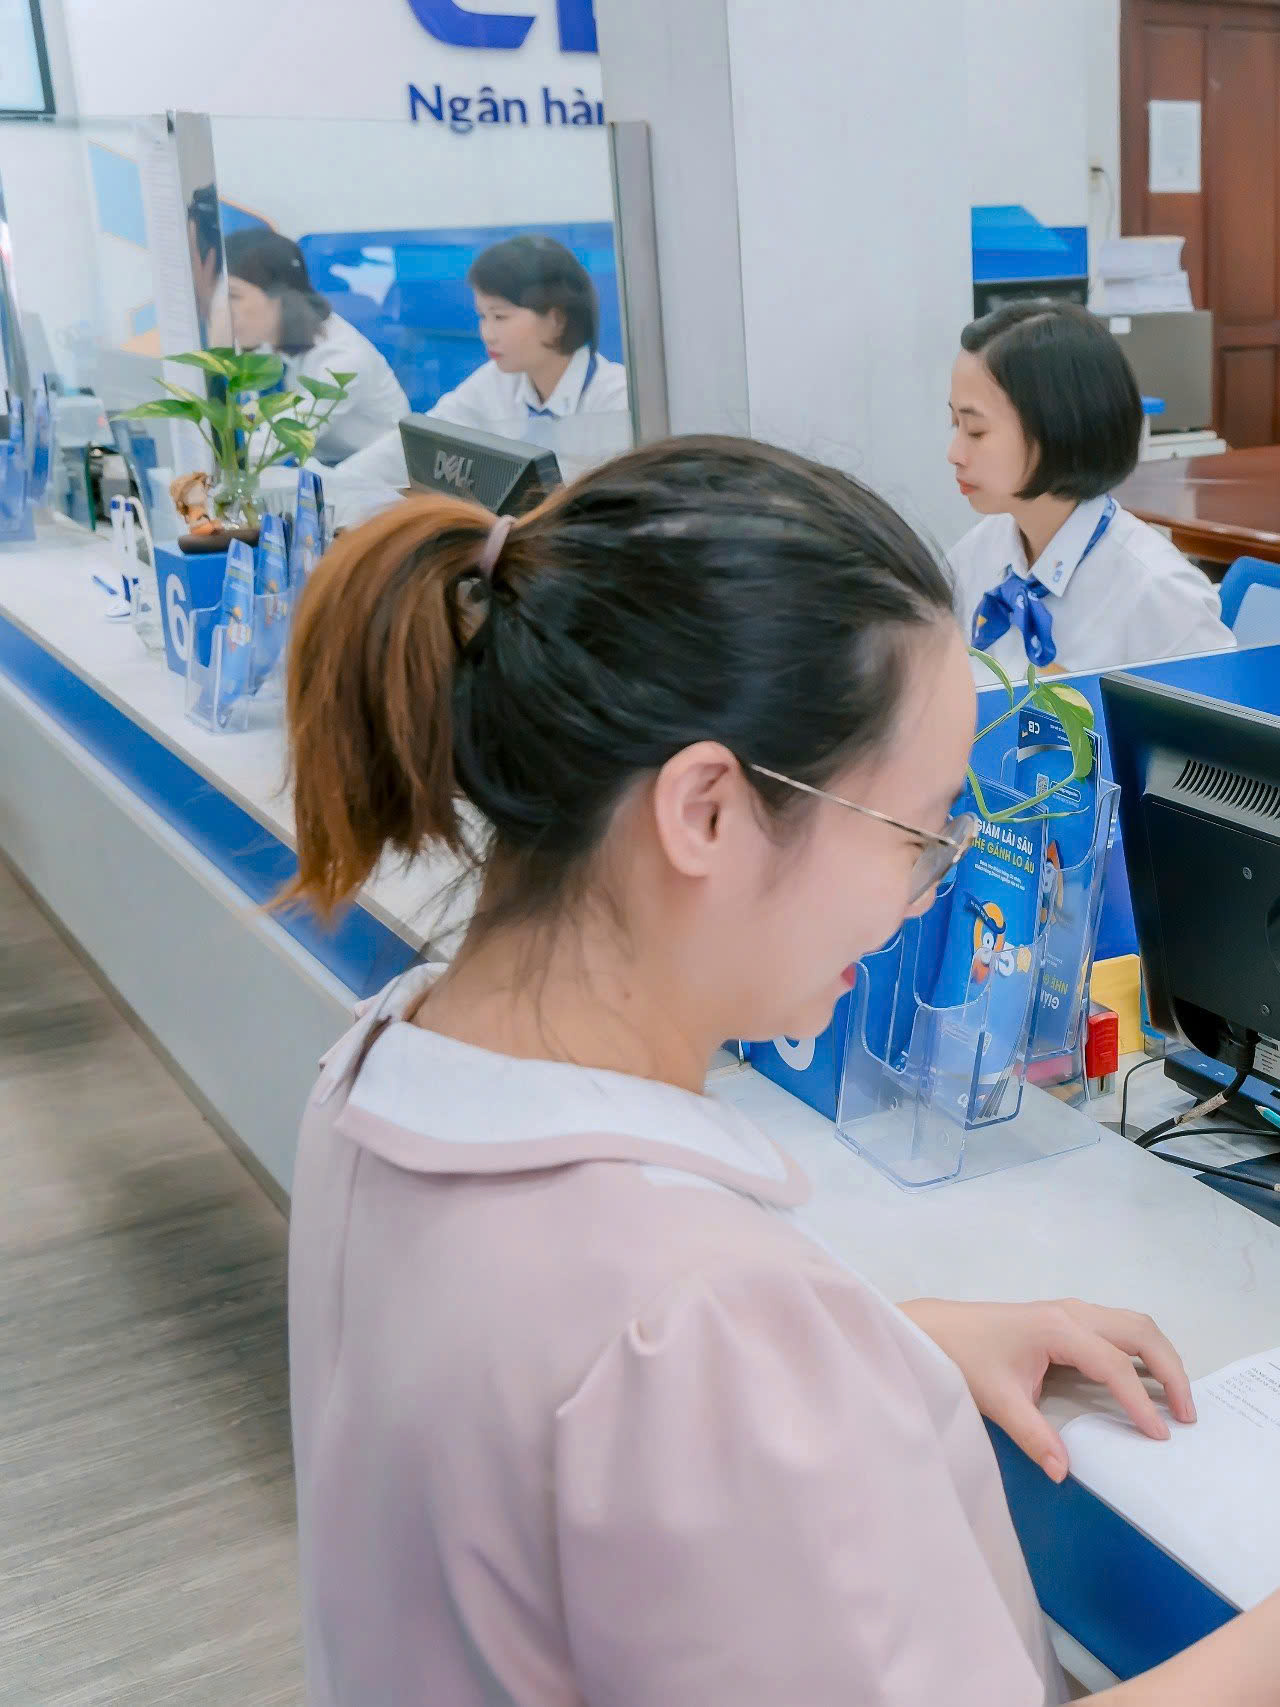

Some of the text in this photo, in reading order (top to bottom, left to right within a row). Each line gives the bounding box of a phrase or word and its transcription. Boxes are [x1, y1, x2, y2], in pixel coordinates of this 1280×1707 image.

[408, 84, 604, 134] Ngân hà
[434, 449, 474, 489] DELL
[165, 573, 194, 662] 6
[1001, 828, 1016, 847] LÃI
[1016, 835, 1034, 856] SÂU
[1012, 852, 1023, 868] LO
